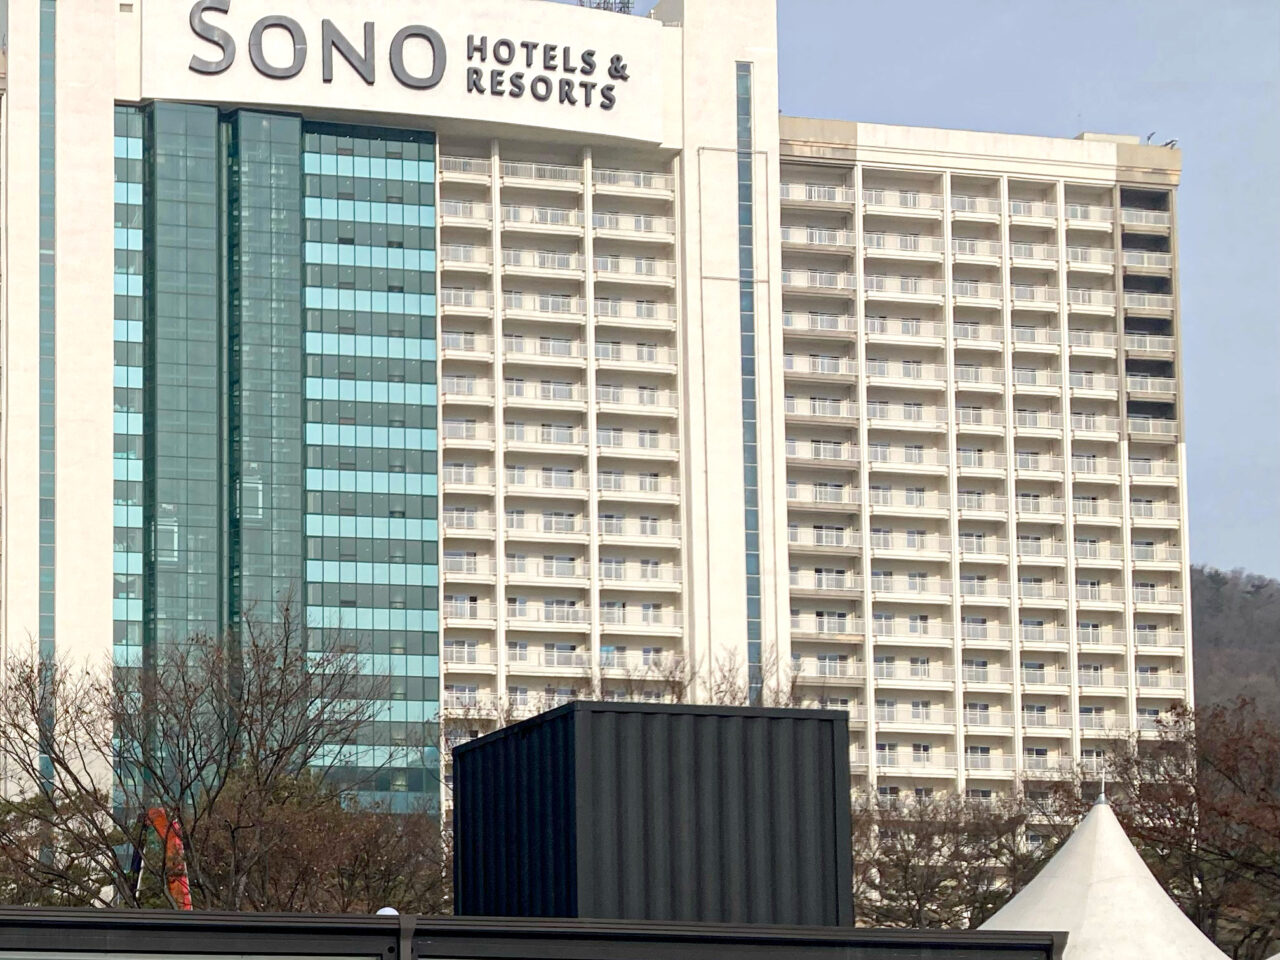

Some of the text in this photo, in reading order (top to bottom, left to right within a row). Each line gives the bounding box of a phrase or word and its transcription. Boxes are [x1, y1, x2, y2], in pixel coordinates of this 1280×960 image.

[188, 0, 631, 90] SONO HOTELS &
[466, 67, 618, 111] RESORTS
